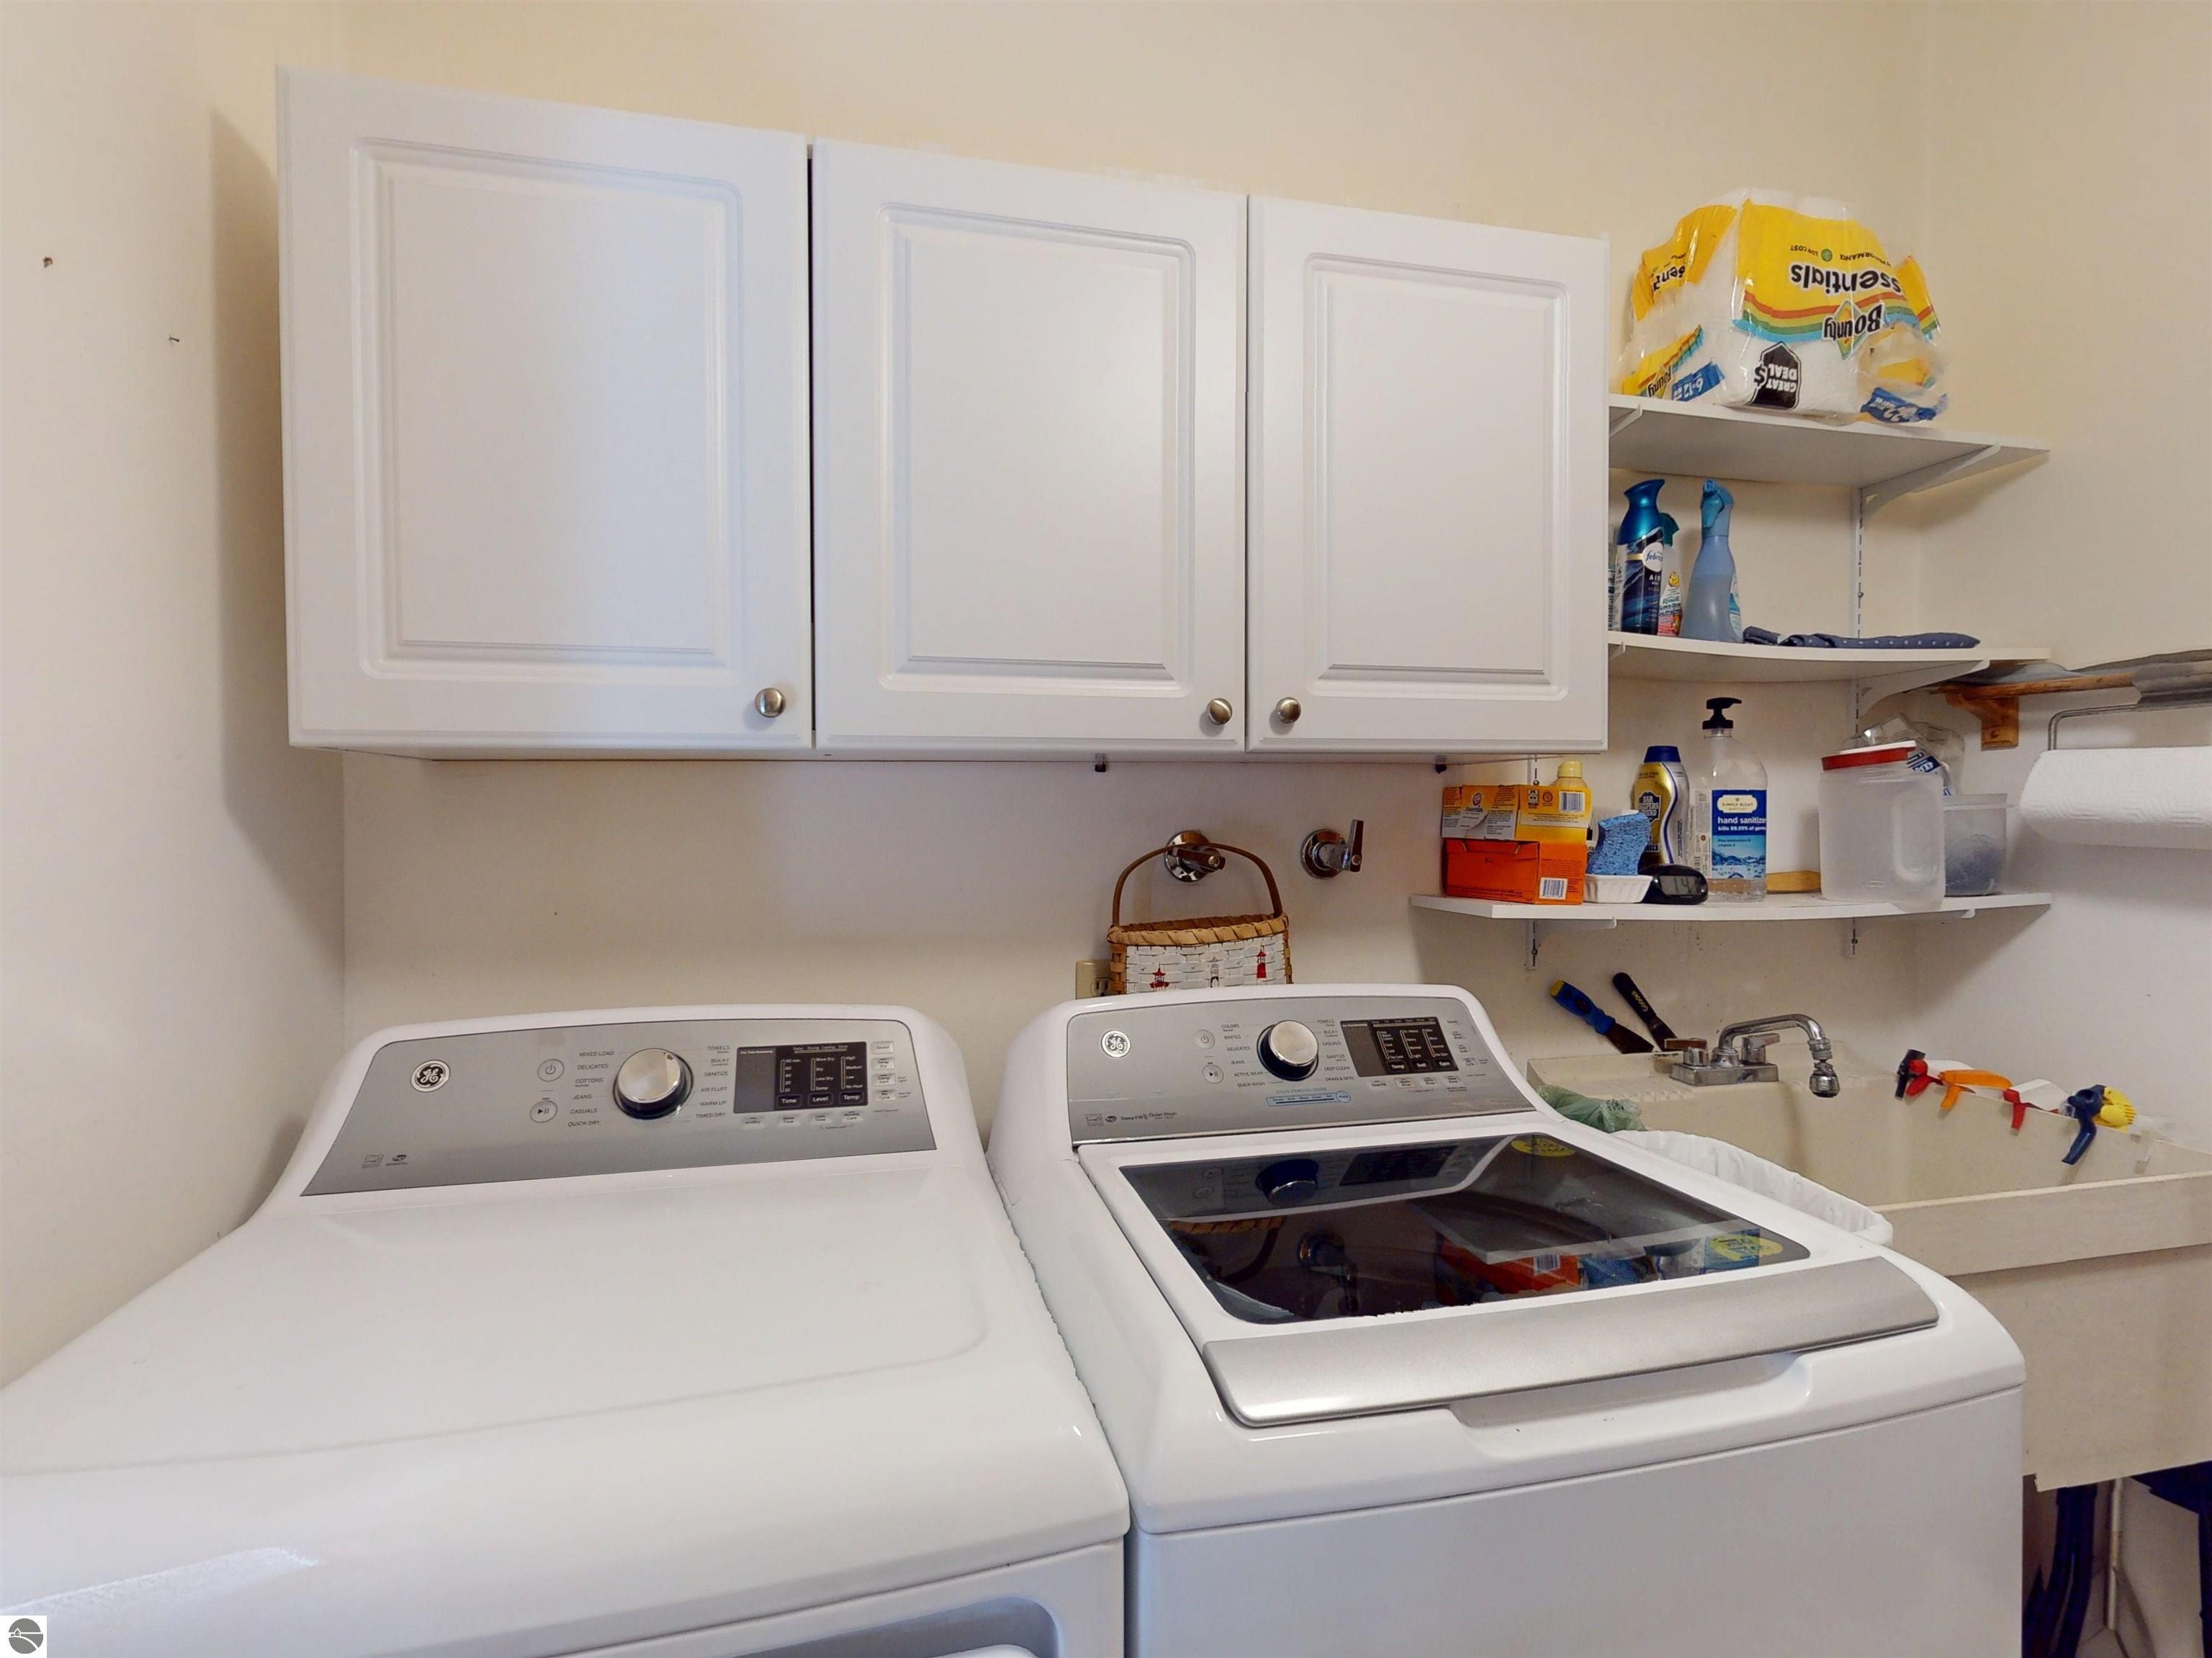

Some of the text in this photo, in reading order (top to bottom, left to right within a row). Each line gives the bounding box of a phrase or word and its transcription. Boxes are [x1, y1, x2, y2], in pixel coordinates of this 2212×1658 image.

[1790, 244, 1807, 253] COST
[1791, 264, 1902, 294] ssentials
[1823, 304, 1882, 341] Bounty
[1768, 364, 1797, 380] DEAL
[1766, 378, 1797, 393] GREAT
